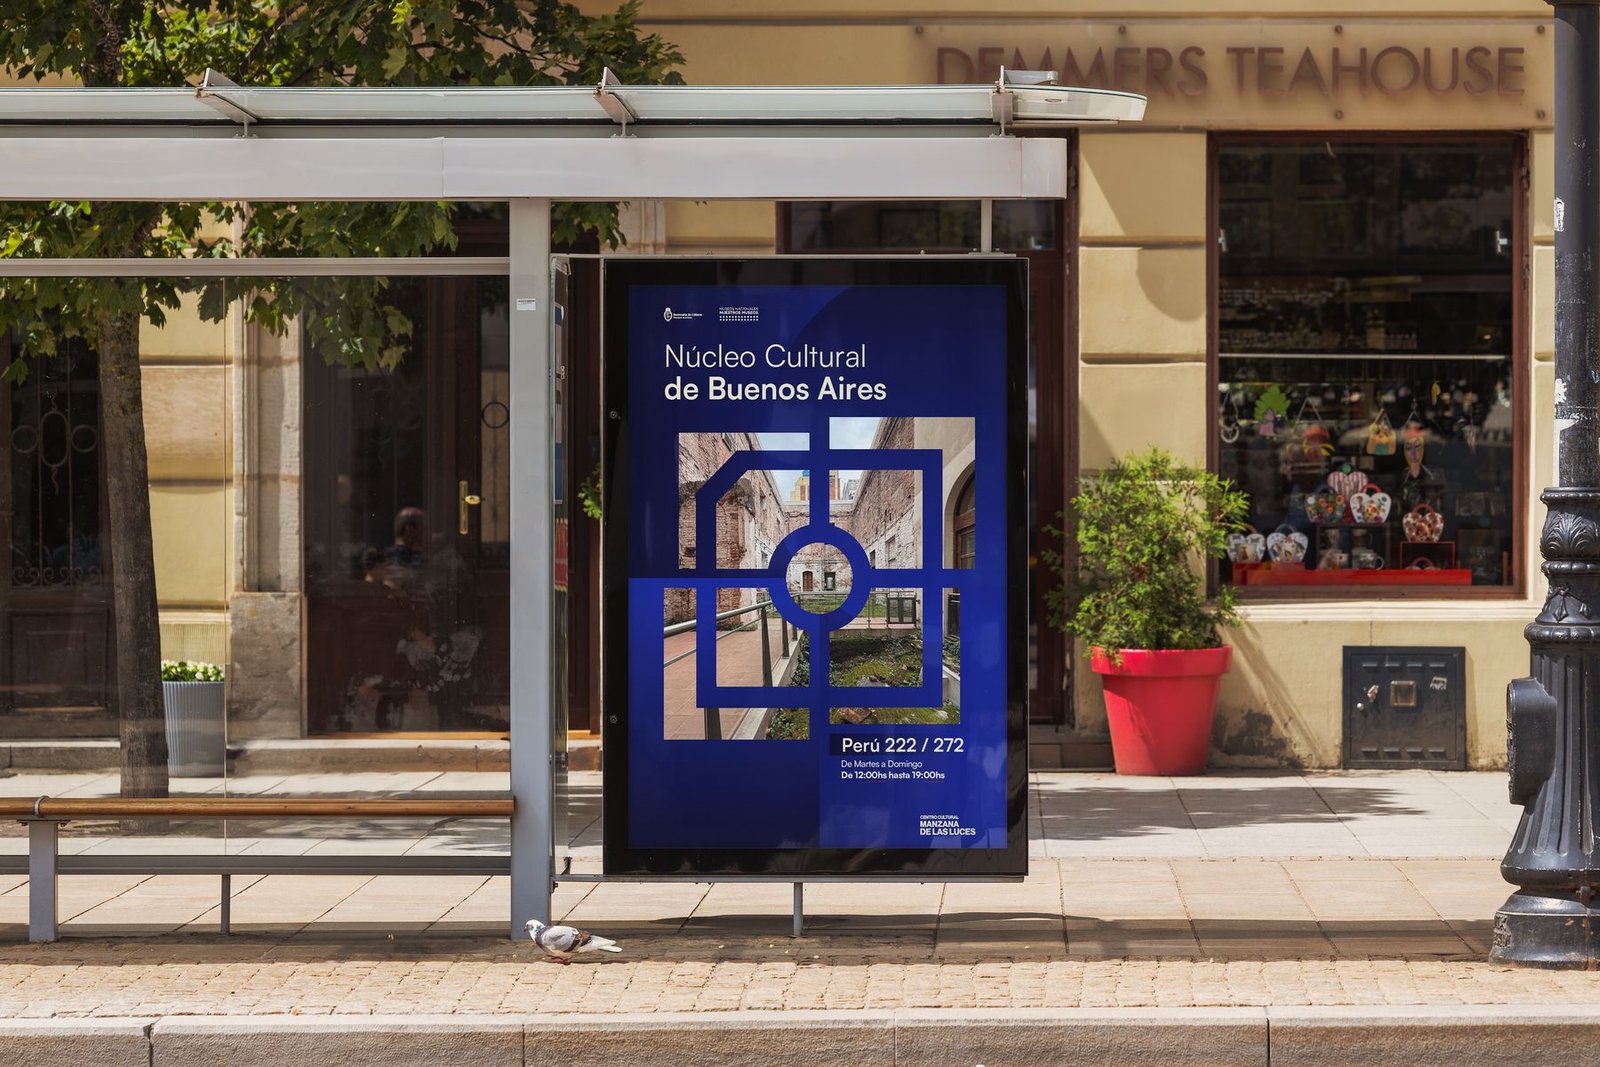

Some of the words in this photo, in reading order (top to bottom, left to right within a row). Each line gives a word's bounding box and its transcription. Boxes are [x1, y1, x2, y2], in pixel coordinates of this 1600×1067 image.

[1226, 46, 1525, 97] TEAHOUSE
[665, 344, 756, 368] Núcleo
[765, 343, 866, 368] Cultural
[664, 375, 699, 401] de
[708, 376, 810, 401] Buenos
[817, 376, 887, 401] Aires
[842, 738, 880, 753] Perú
[885, 737, 917, 753] 222
[921, 737, 929, 753] /
[933, 737, 965, 753] 272
[841, 760, 853, 768] De
[854, 760, 880, 768] Martes
[887, 760, 923, 769] Domingo
[841, 771, 853, 779] De
[855, 771, 887, 779] 12:00hs
[888, 771, 911, 779] hasta
[912, 771, 945, 779] 19:00hs
[920, 828, 931, 836] DE
[932, 828, 948, 836] LAS
[949, 828, 976, 836] LUCES
